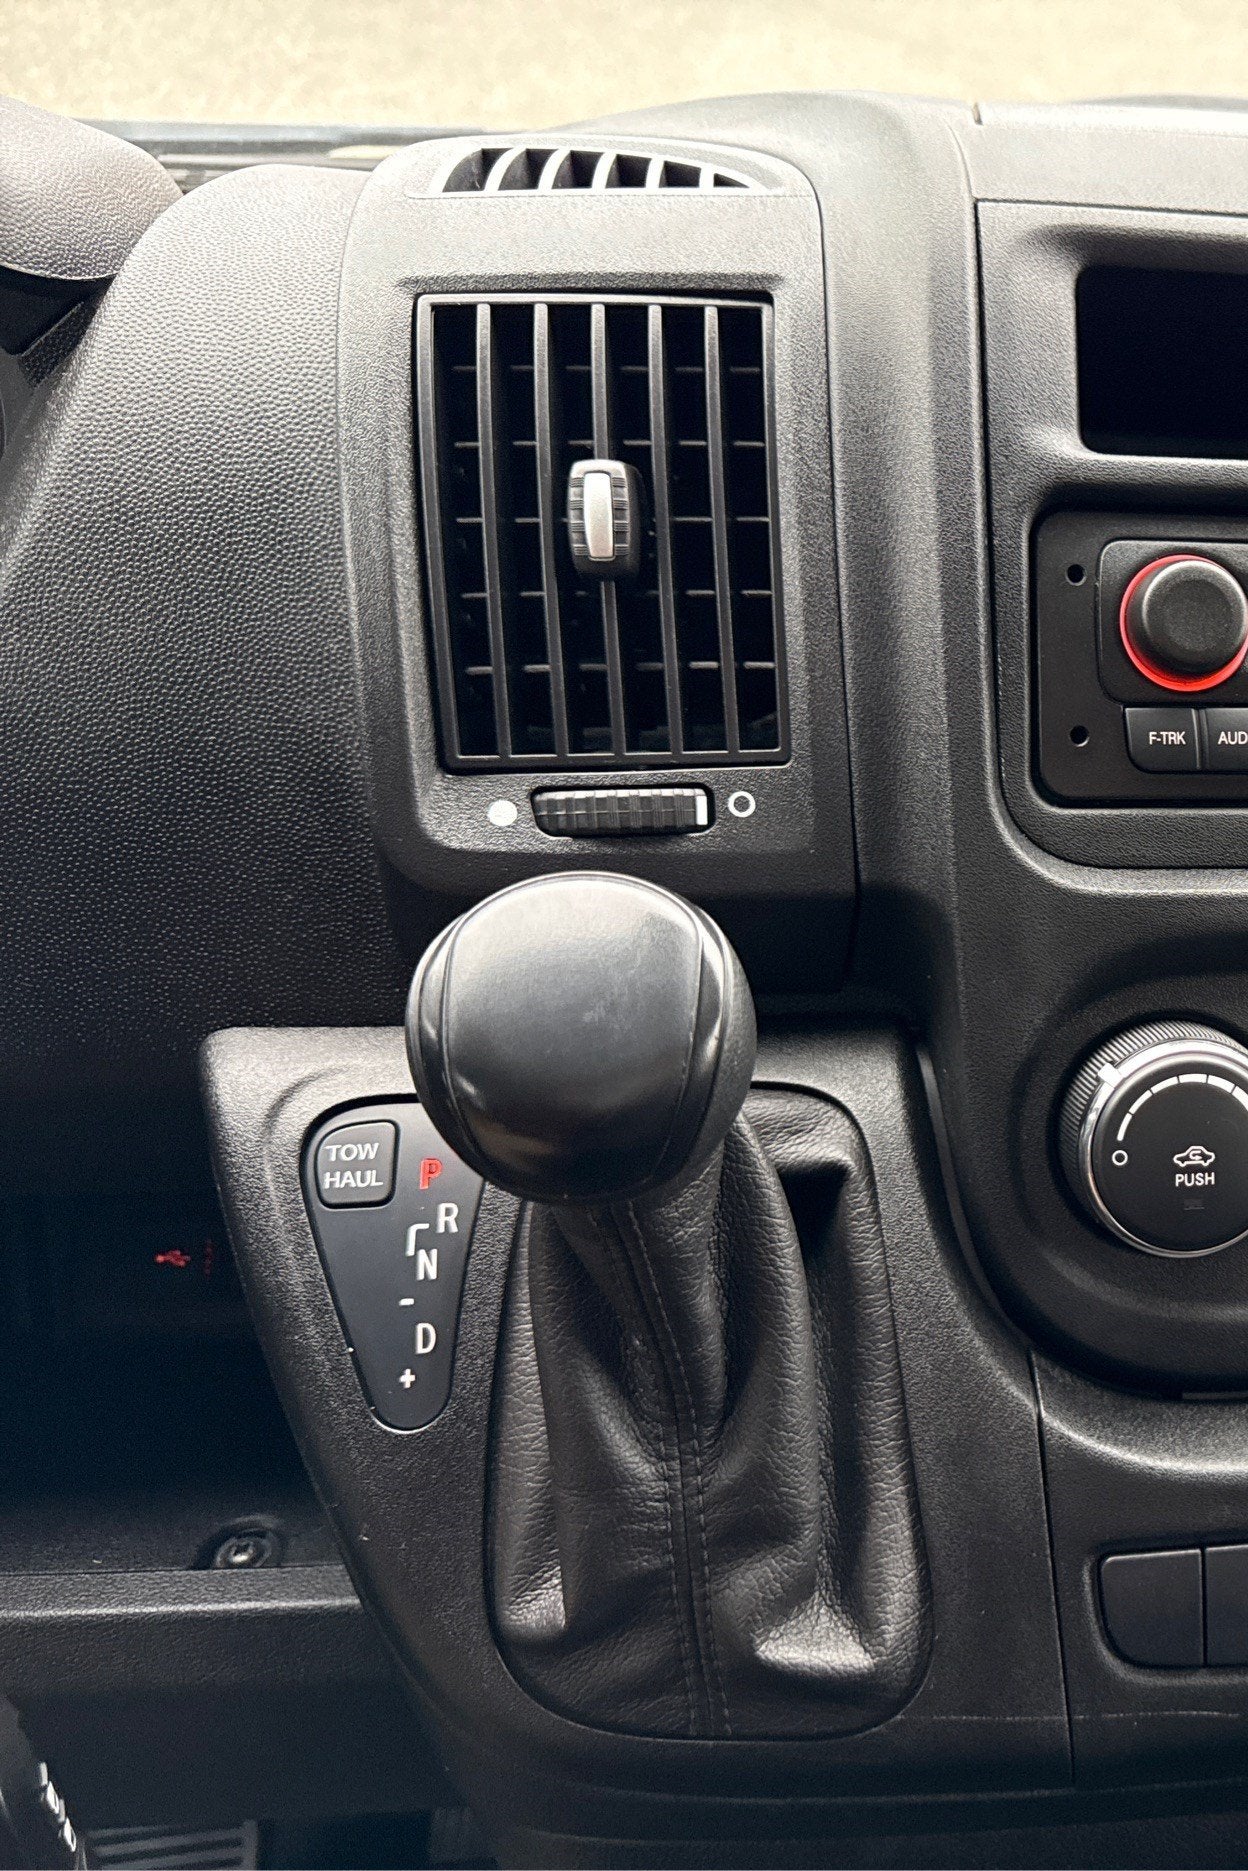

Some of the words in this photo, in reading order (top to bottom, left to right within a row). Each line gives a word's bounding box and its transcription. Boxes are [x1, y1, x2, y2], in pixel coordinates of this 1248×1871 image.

[1149, 731, 1186, 745] F-TRK
[325, 1142, 379, 1161] TOW
[323, 1170, 383, 1189] HAUL
[419, 1158, 443, 1189] P
[1175, 1171, 1216, 1187] PUSH
[437, 1202, 459, 1234] R
[416, 1249, 438, 1281] N
[416, 1323, 437, 1354] D
